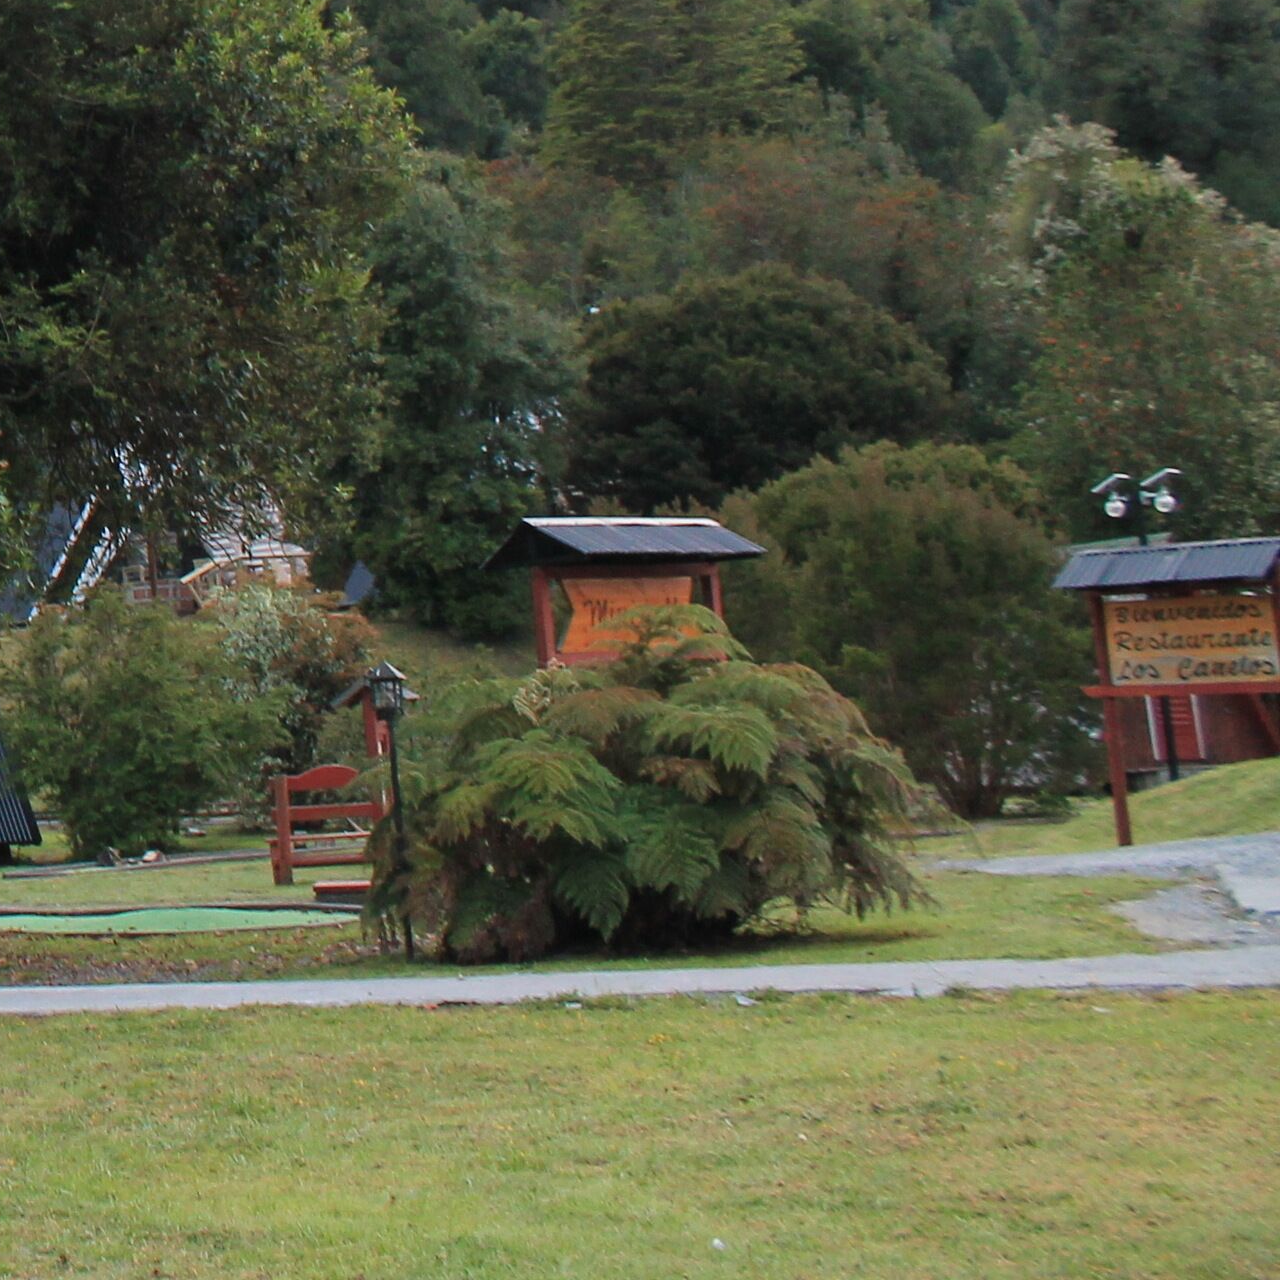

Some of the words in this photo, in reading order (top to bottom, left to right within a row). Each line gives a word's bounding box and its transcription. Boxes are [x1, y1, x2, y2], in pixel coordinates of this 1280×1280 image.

[1114, 600, 1262, 623] Bienvenidos
[1114, 627, 1272, 651] Restaurante
[1116, 660, 1159, 680] Los
